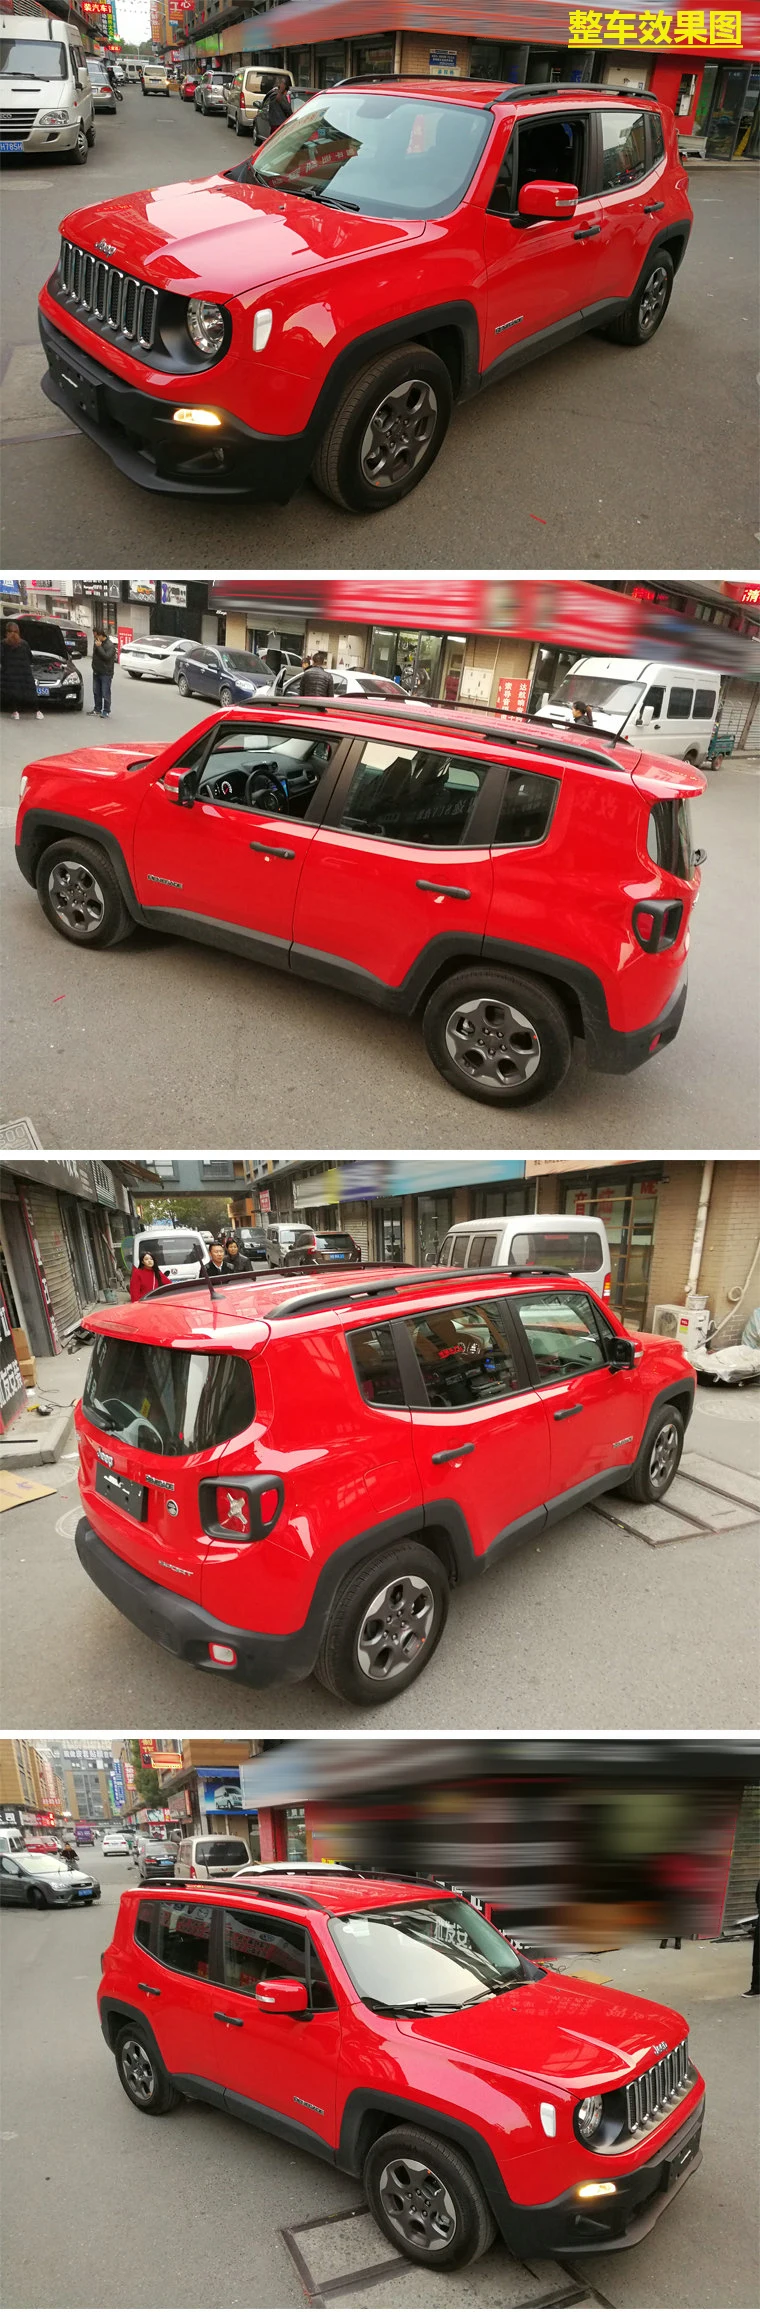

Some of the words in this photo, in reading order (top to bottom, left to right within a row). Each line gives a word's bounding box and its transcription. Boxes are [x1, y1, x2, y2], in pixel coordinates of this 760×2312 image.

[94, 238, 116, 257] Jeep
[96, 1446, 115, 1468] Jeep
[158, 1559, 194, 1576] SPORT
[653, 2041, 668, 2056] Jeep
